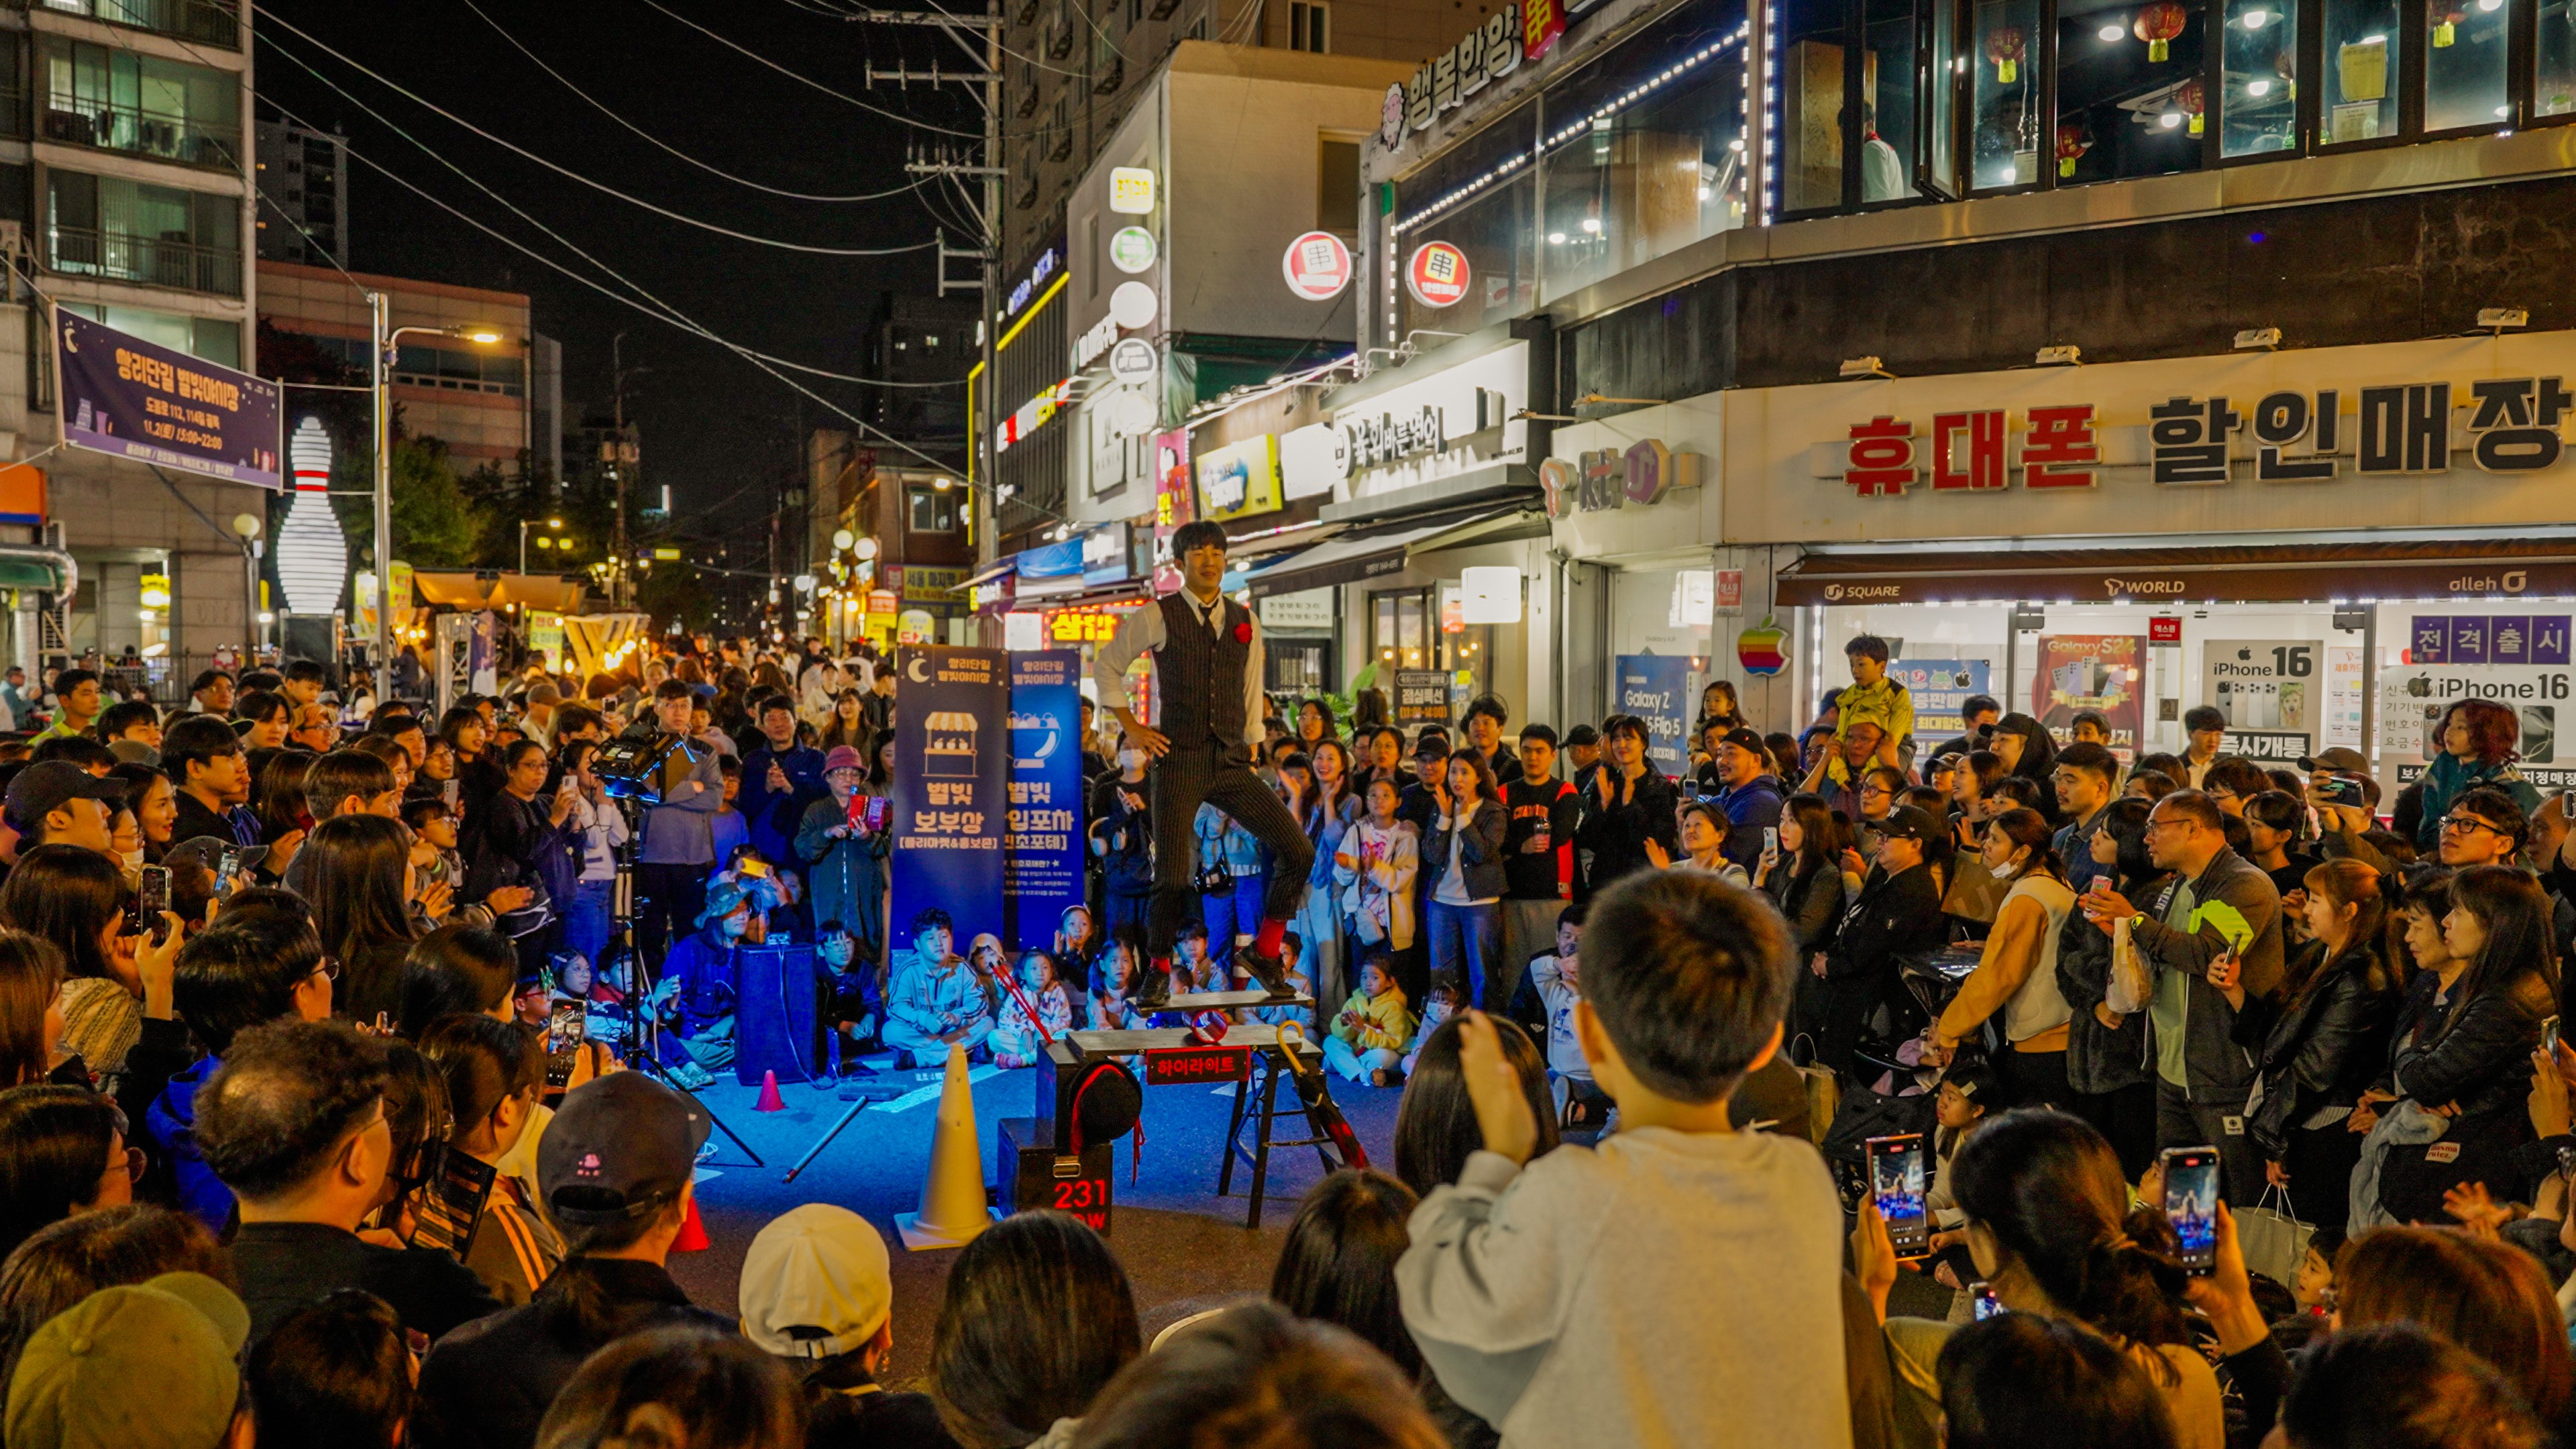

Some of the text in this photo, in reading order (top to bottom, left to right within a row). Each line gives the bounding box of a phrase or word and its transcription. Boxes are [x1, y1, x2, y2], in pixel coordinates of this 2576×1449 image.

[1410, 4, 1517, 129] 행복한양
[1309, 244, 1330, 268] 串
[1430, 252, 1453, 278] 串
[115, 347, 239, 413] 쌍리단길 별빛야시장
[1844, 376, 2575, 497] 휴대폰 할인매장
[1847, 585, 1901, 598] SQUARE
[2125, 580, 2186, 594] WORLD
[2449, 575, 2497, 592] olleh
[2153, 625, 2176, 633] 에스원
[2047, 638, 2137, 655] Galaxy S24
[2418, 628, 2563, 655] 전격출시
[949, 658, 991, 670] 쌍리단길
[1022, 661, 1064, 672] 쌍리단길
[2214, 647, 2312, 677] iPhone 16
[938, 670, 991, 683] 별빛야시장
[1013, 674, 1065, 684] 별빛야시장
[1626, 676, 1648, 684] SAMSUNG
[2439, 674, 2569, 700] iPhone 16
[1625, 690, 1670, 714] Galaxy Z
[2386, 702, 2423, 715] 기기변
[2384, 737, 2423, 749] 요금수
[927, 783, 972, 805] 별빛
[1008, 782, 1051, 804] 별빛
[914, 811, 984, 834] 보부상
[1006, 809, 1075, 832] 입포차
[1157, 1055, 1236, 1077] 하이라이트
[1055, 1179, 1106, 1209] 231
